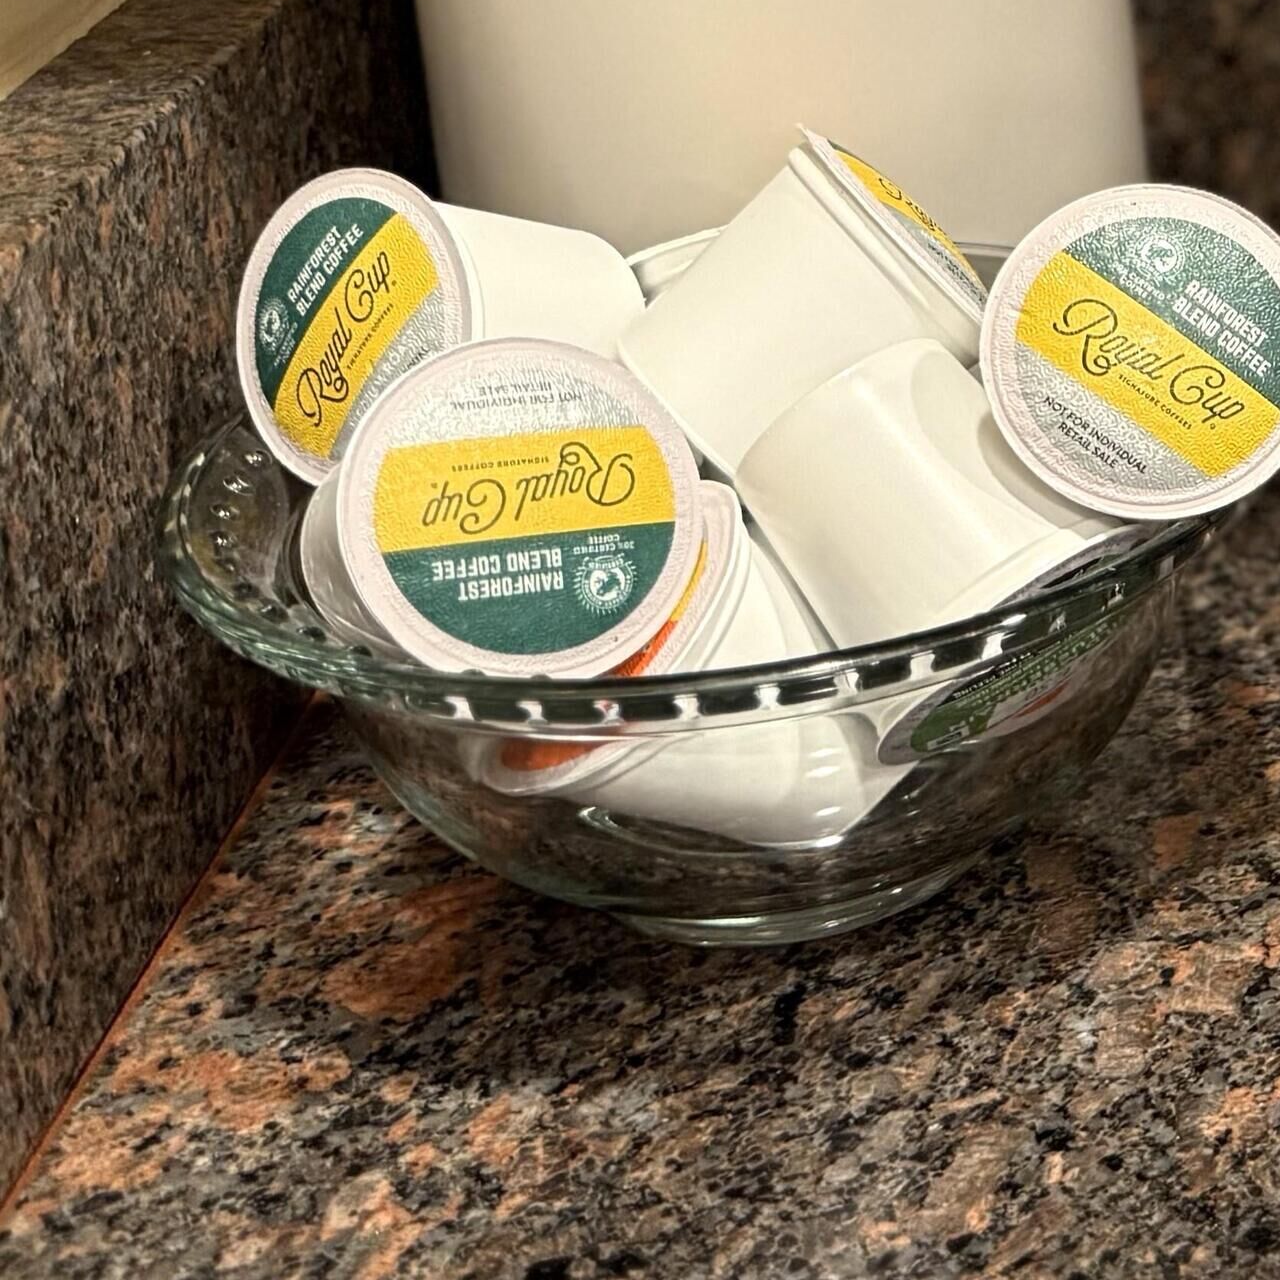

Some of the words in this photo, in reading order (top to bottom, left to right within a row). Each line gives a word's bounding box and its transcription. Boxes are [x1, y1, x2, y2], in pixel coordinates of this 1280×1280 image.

[286, 225, 342, 303] RAINFOREST
[295, 272, 327, 317] BLEND
[322, 223, 364, 275] COFFEE
[296, 306, 353, 427] Royal
[344, 251, 390, 323] Cup
[1172, 296, 1221, 338] BLEND
[1217, 329, 1272, 378] COFFEE
[1184, 280, 1270, 347] RAINFOREST
[1052, 298, 1185, 381] Royal
[1169, 365, 1246, 425] Cup
[451, 461, 495, 473] COFFEES
[496, 455, 550, 469] SIGNATURE
[1043, 395, 1068, 419] NOT
[1066, 411, 1089, 433] FOR
[1088, 427, 1148, 475] INDIVIDUAL
[1058, 421, 1091, 452] RETAIL
[1091, 447, 1119, 469] SALE
[422, 477, 508, 536] Cup
[514, 441, 636, 522] Royal
[431, 553, 501, 582] COFFEE
[457, 570, 564, 602] RAINFOREST
[506, 547, 563, 571] BLEND
